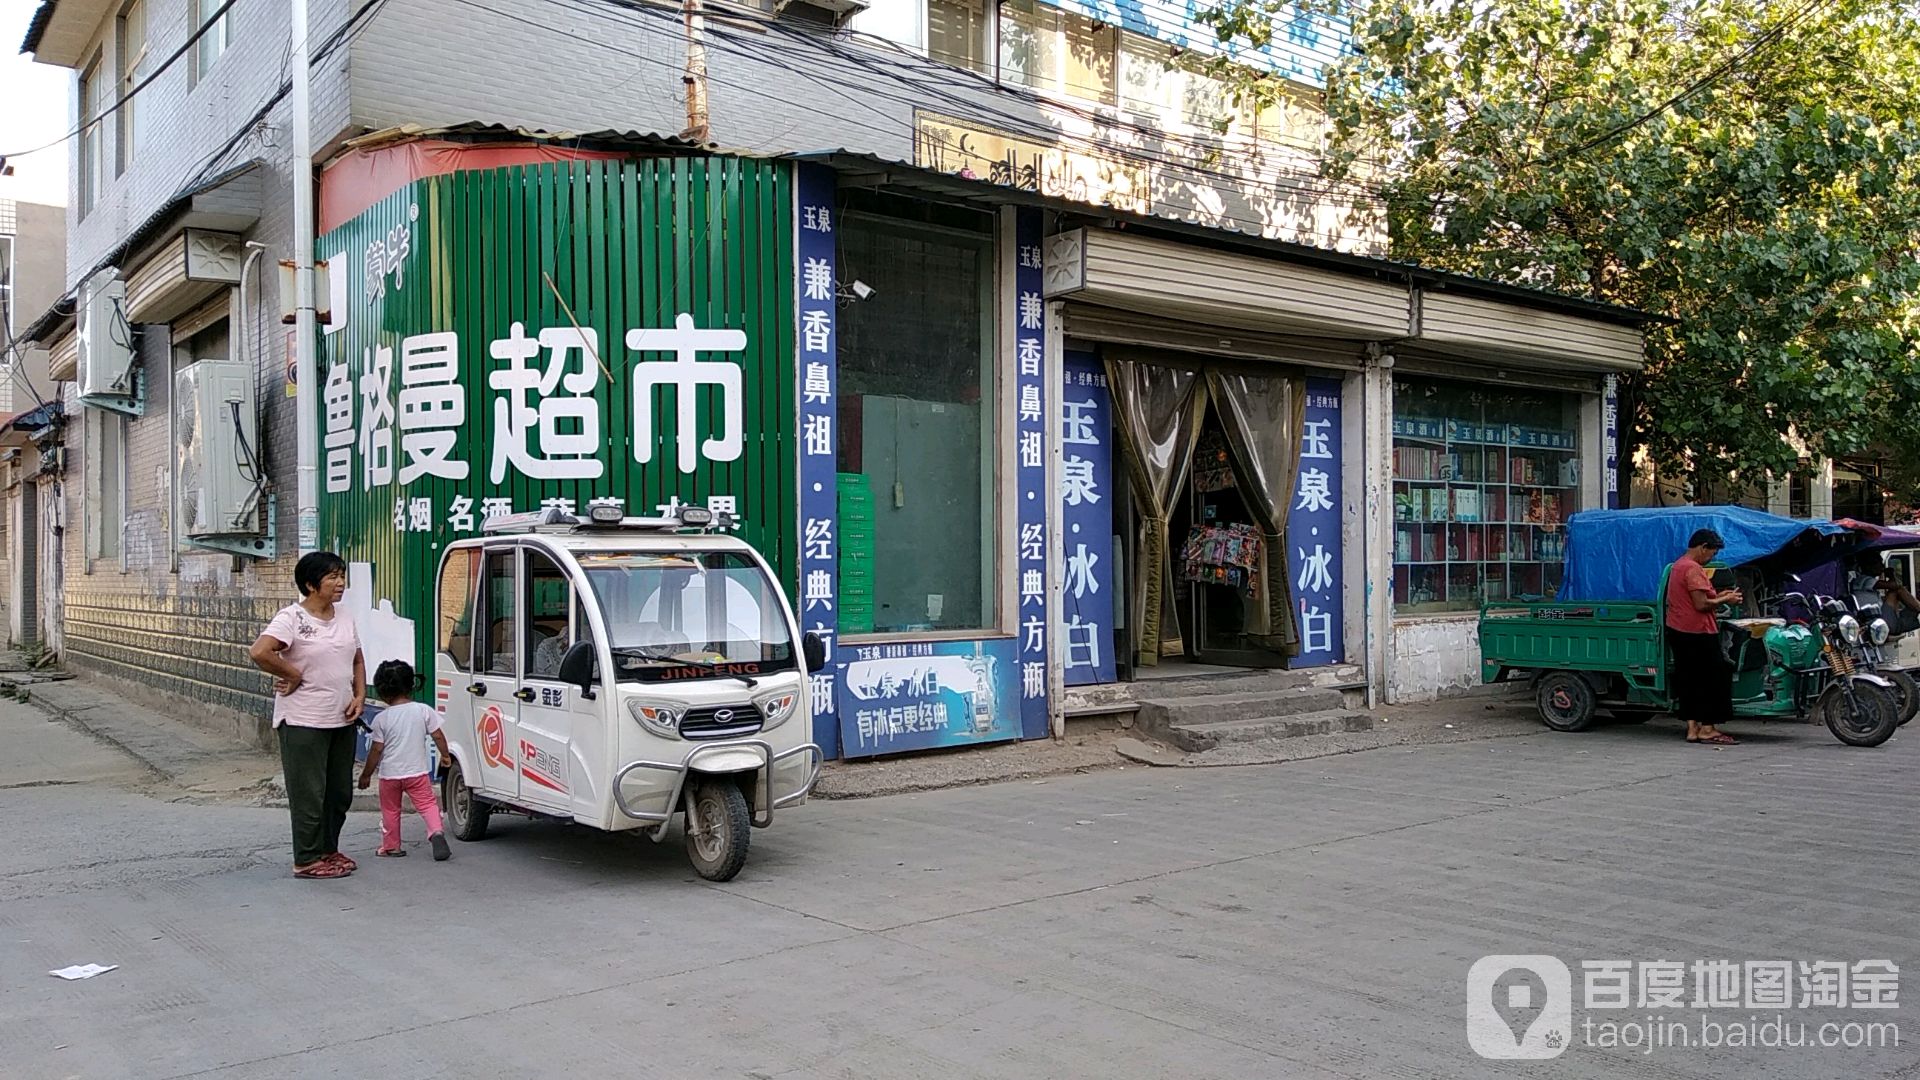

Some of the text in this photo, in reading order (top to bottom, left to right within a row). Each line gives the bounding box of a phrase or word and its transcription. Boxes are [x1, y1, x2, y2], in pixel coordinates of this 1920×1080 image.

[804, 206, 831, 233] 玉泉
[366, 223, 410, 306] 蒙牛
[1020, 246, 1042, 268] 玉泉
[324, 312, 748, 494] 鲁格曼超市
[393, 497, 433, 532] 名烟
[1296, 417, 1336, 654] 玉泉·冰白
[660, 663, 760, 680] JINPENG
[856, 700, 949, 748] 有冰点更经典
